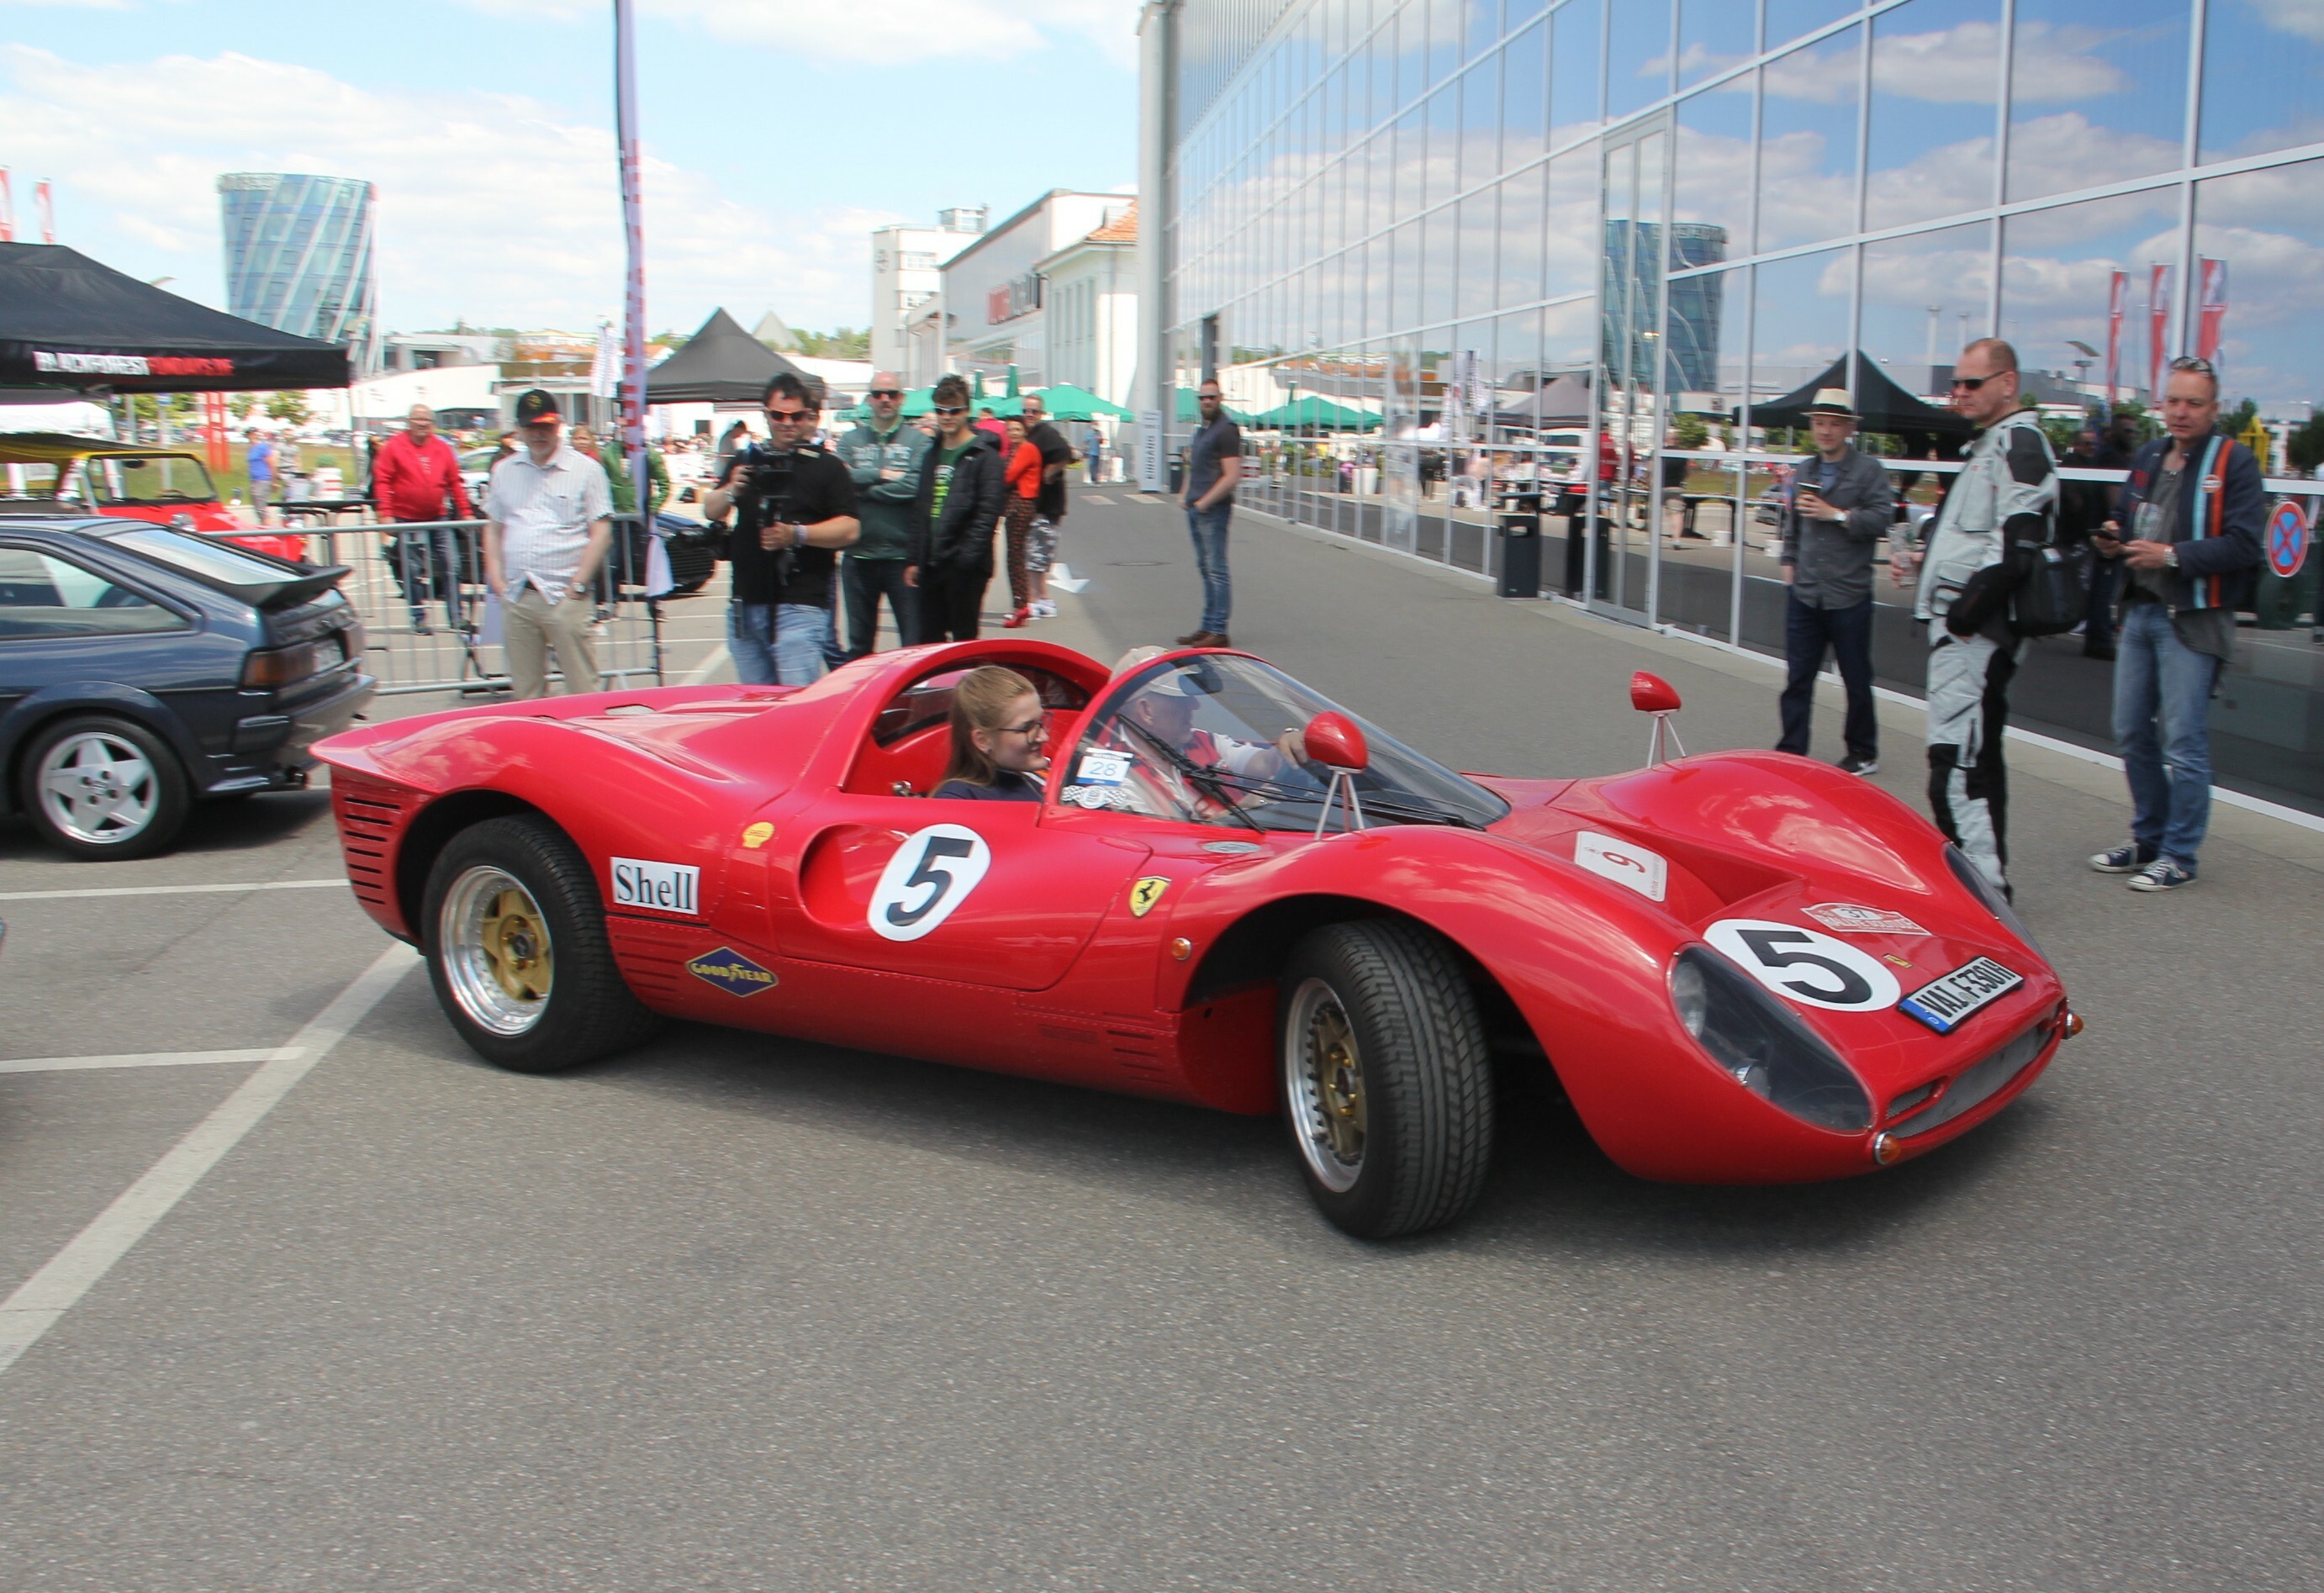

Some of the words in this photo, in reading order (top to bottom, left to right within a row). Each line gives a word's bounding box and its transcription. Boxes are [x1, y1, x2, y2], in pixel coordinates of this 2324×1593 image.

[1089, 761, 1117, 777] 28
[615, 864, 693, 910] Shell
[885, 835, 975, 927] 5
[1841, 909, 1868, 919] 37
[1735, 929, 1872, 1005] 5
[1915, 984, 1969, 1018] VAI
